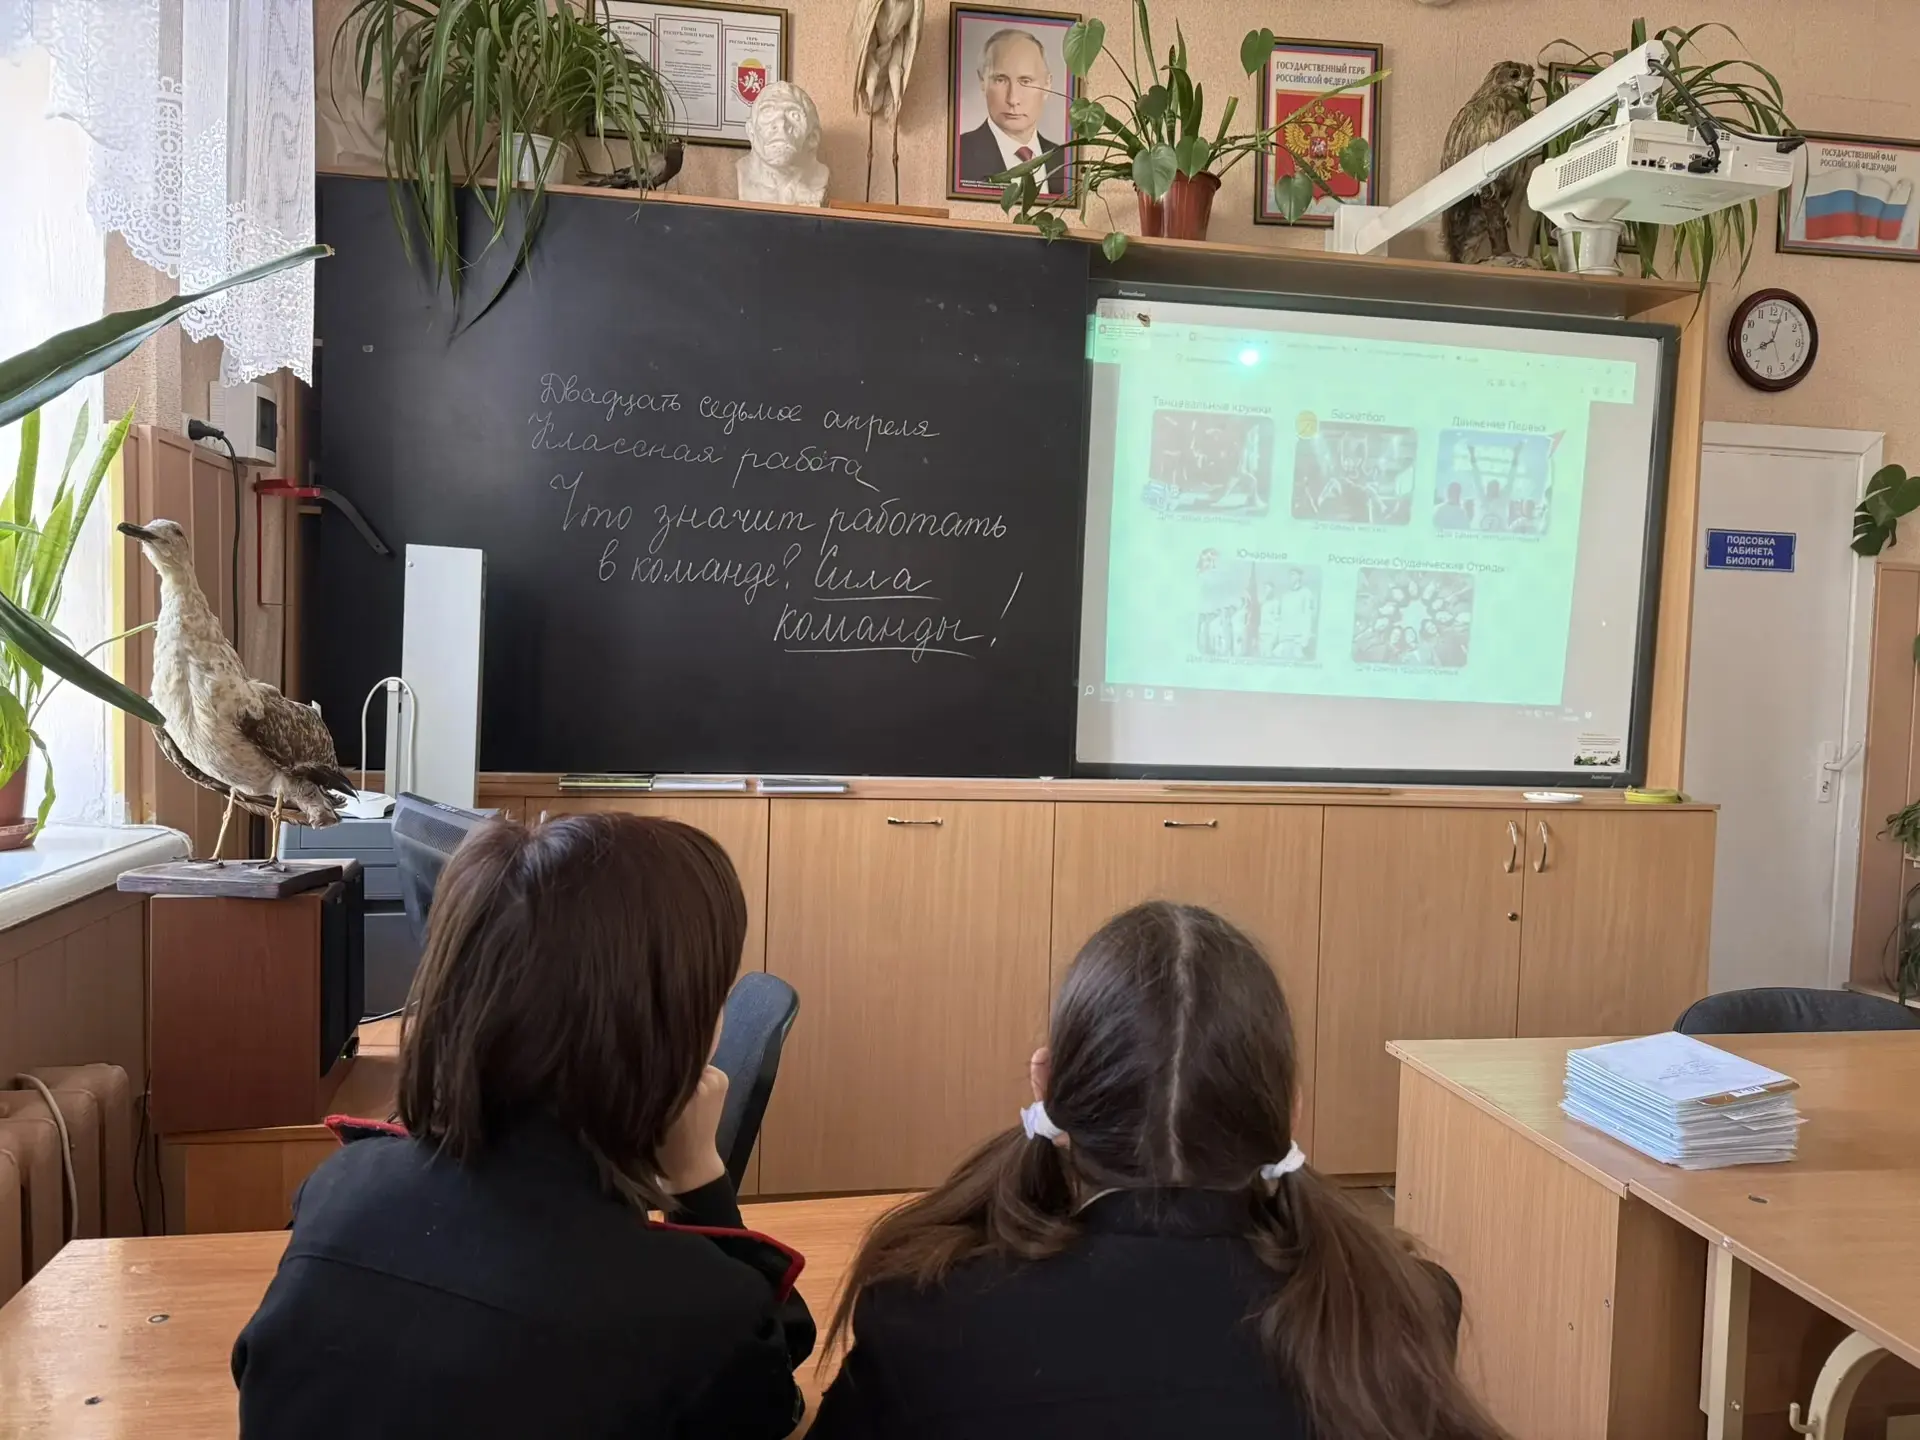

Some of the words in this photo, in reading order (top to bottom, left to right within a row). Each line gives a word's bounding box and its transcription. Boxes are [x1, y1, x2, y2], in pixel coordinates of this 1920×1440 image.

[1276, 60, 1347, 74] ГОСУДАРСТВЕННЫЙ
[1348, 66, 1366, 75] ГЕРБ
[1276, 73, 1322, 85] РОССИЙСКОЙ
[1821, 148, 1880, 160] ГОСУДАРСТВЕННЫЙ
[1881, 152, 1898, 161] ФЛАГ
[1820, 158, 1860, 169] РОССИЙСКОЙ
[1861, 162, 1897, 173] ФЕДЕРАЦИИ
[1758, 310, 1764, 319] 11
[1770, 306, 1778, 316] 12
[1784, 312, 1788, 321] 1
[1747, 320, 1755, 329] 10
[1792, 324, 1797, 333] 2
[1742, 333, 1748, 343] 9
[1795, 338, 1800, 348] 3
[1746, 349, 1752, 358] 8
[1789, 353, 1796, 362] 4
[1754, 360, 1760, 369] 7
[1766, 365, 1772, 374] 6
[1779, 362, 1786, 371] 5
[541, 372, 682, 422] Двадцать
[699, 396, 802, 434] седьмое
[824, 408, 940, 452] апреля
[528, 410, 723, 463] Классная
[733, 446, 880, 492] работа
[549, 472, 632, 530] Что
[649, 502, 815, 552] значит
[820, 498, 1007, 555] работать
[1726, 535, 1776, 546] ПОДСОБКА
[1727, 546, 1774, 556] КАБИНЕТА
[1725, 556, 1775, 567] БИОЛОГИИ
[598, 540, 617, 582] в
[632, 543, 801, 604] команде?
[814, 546, 932, 593] Сила
